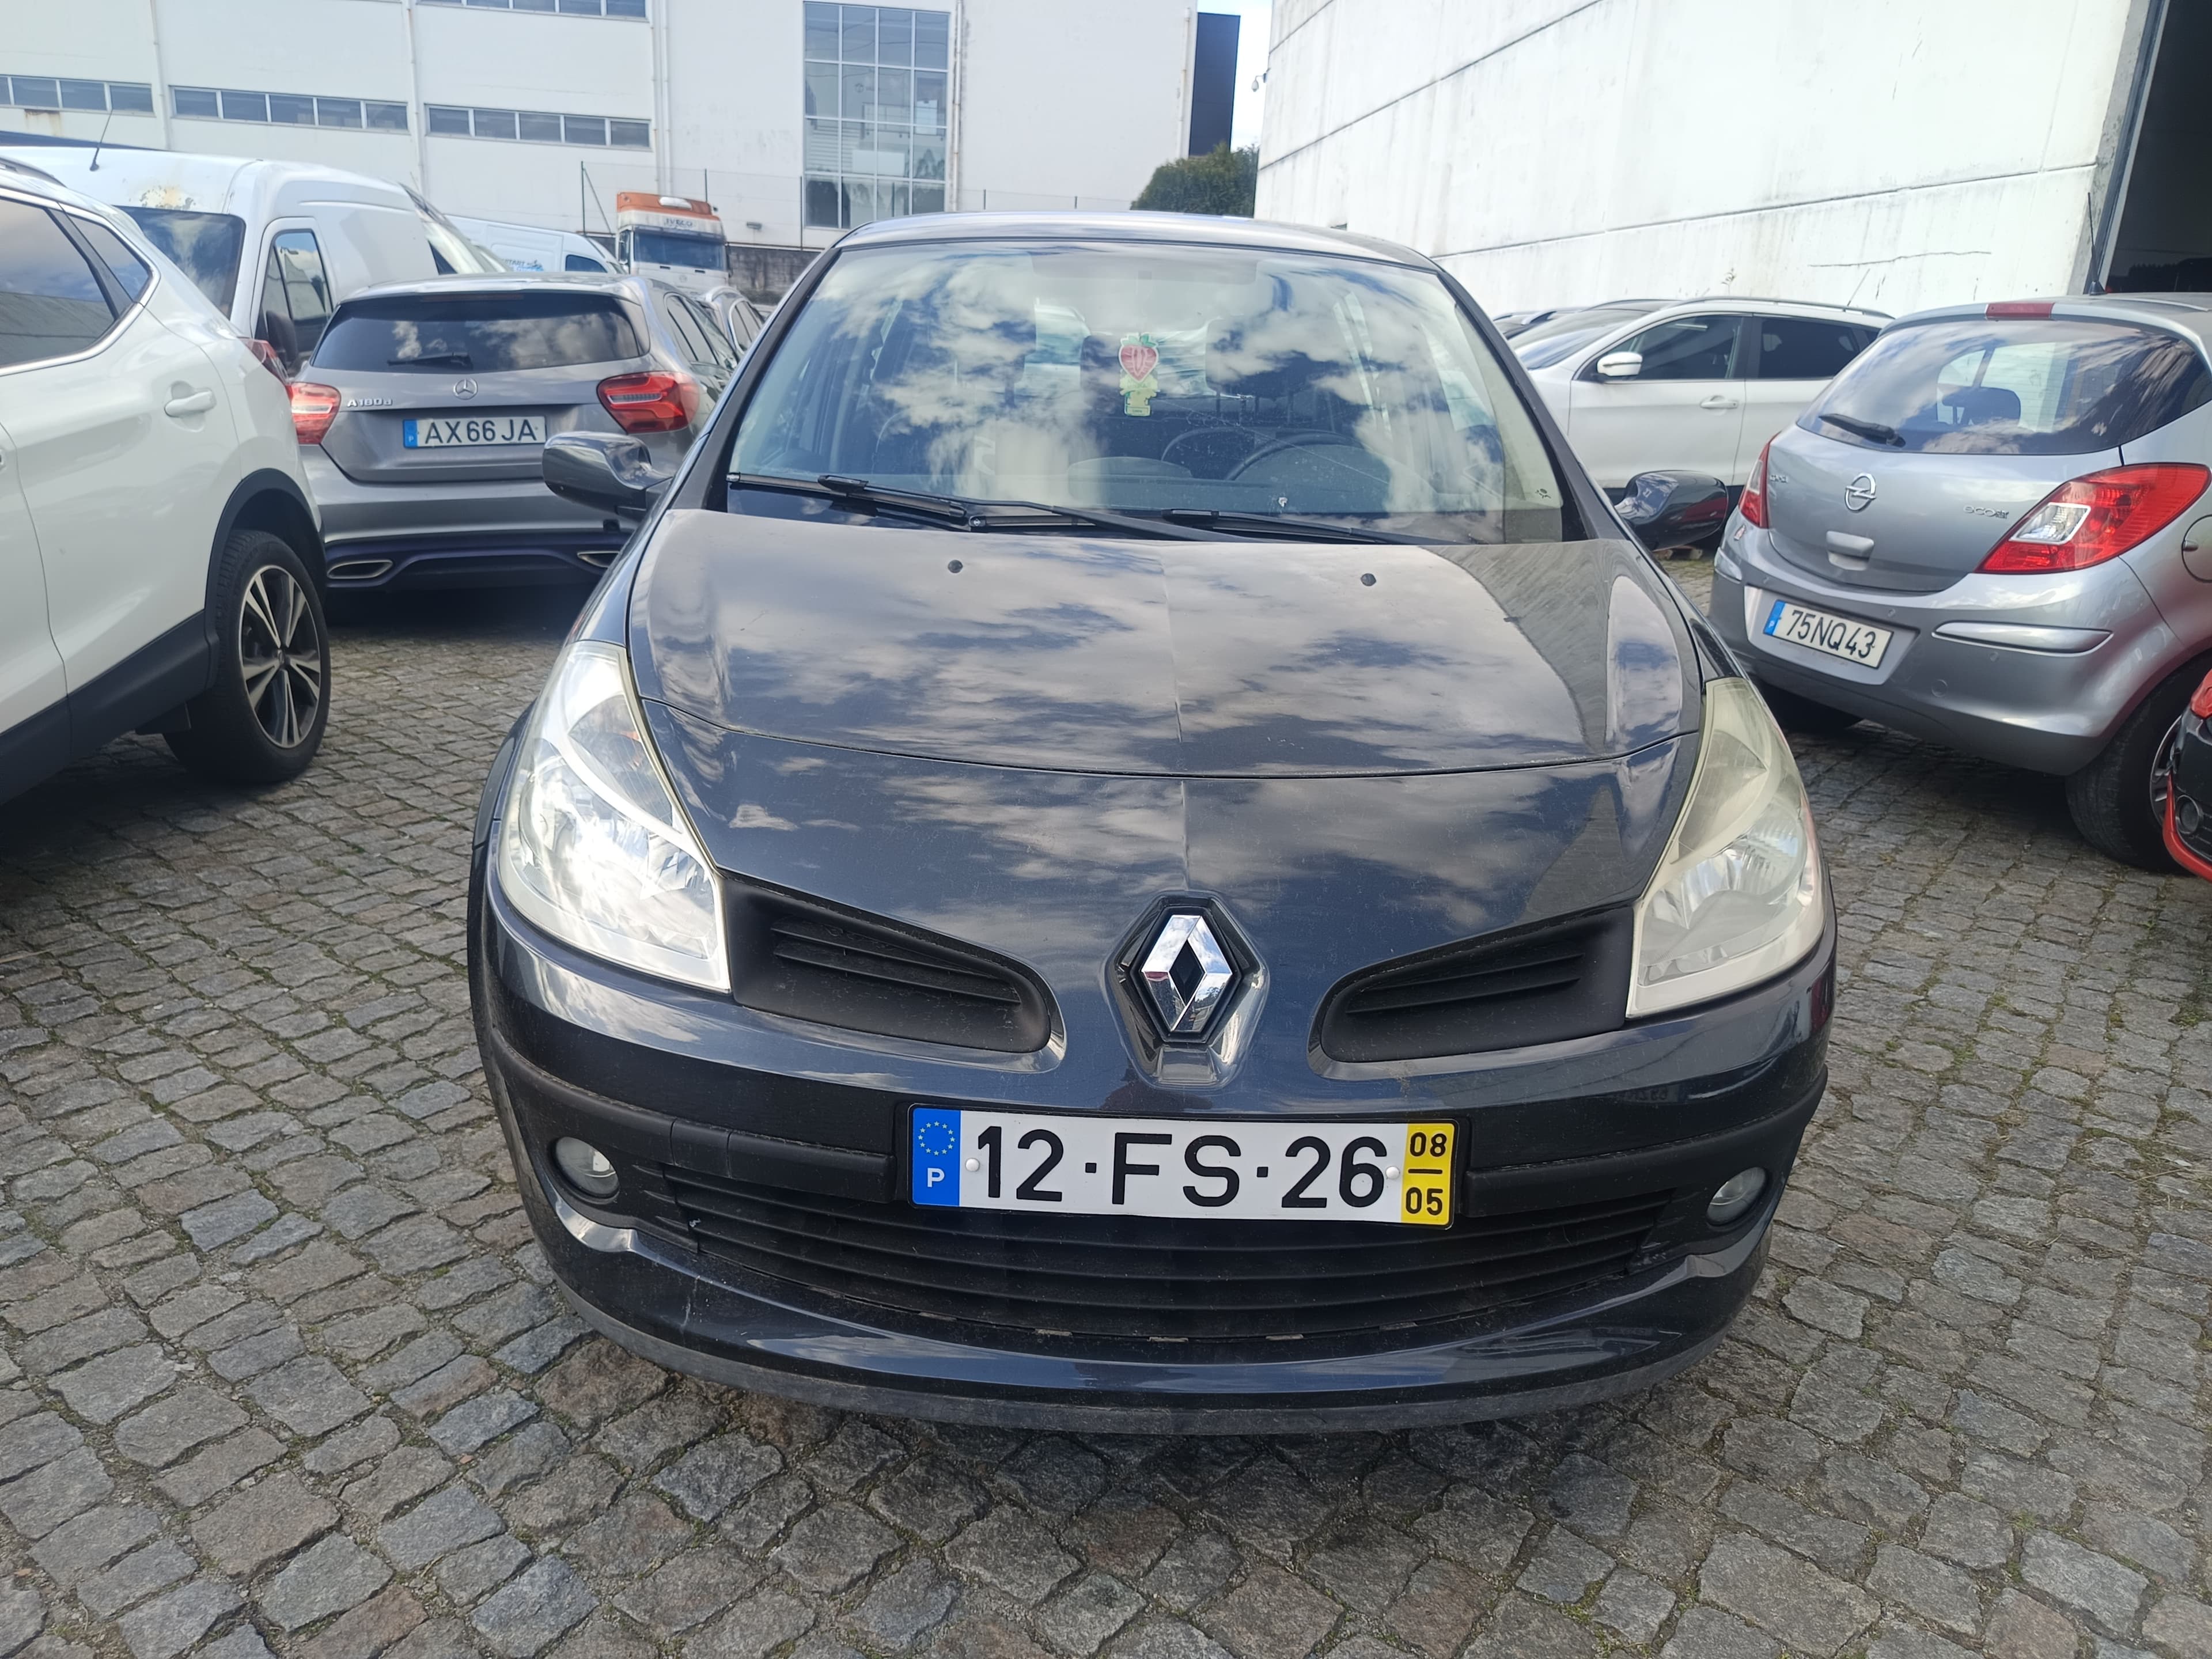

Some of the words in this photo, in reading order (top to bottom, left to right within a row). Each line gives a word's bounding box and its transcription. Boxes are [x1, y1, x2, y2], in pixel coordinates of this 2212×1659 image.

[408, 435, 414, 443] P
[1410, 1131, 1447, 1157] 08
[927, 1168, 945, 1187] P
[1406, 1187, 1443, 1215] 05
